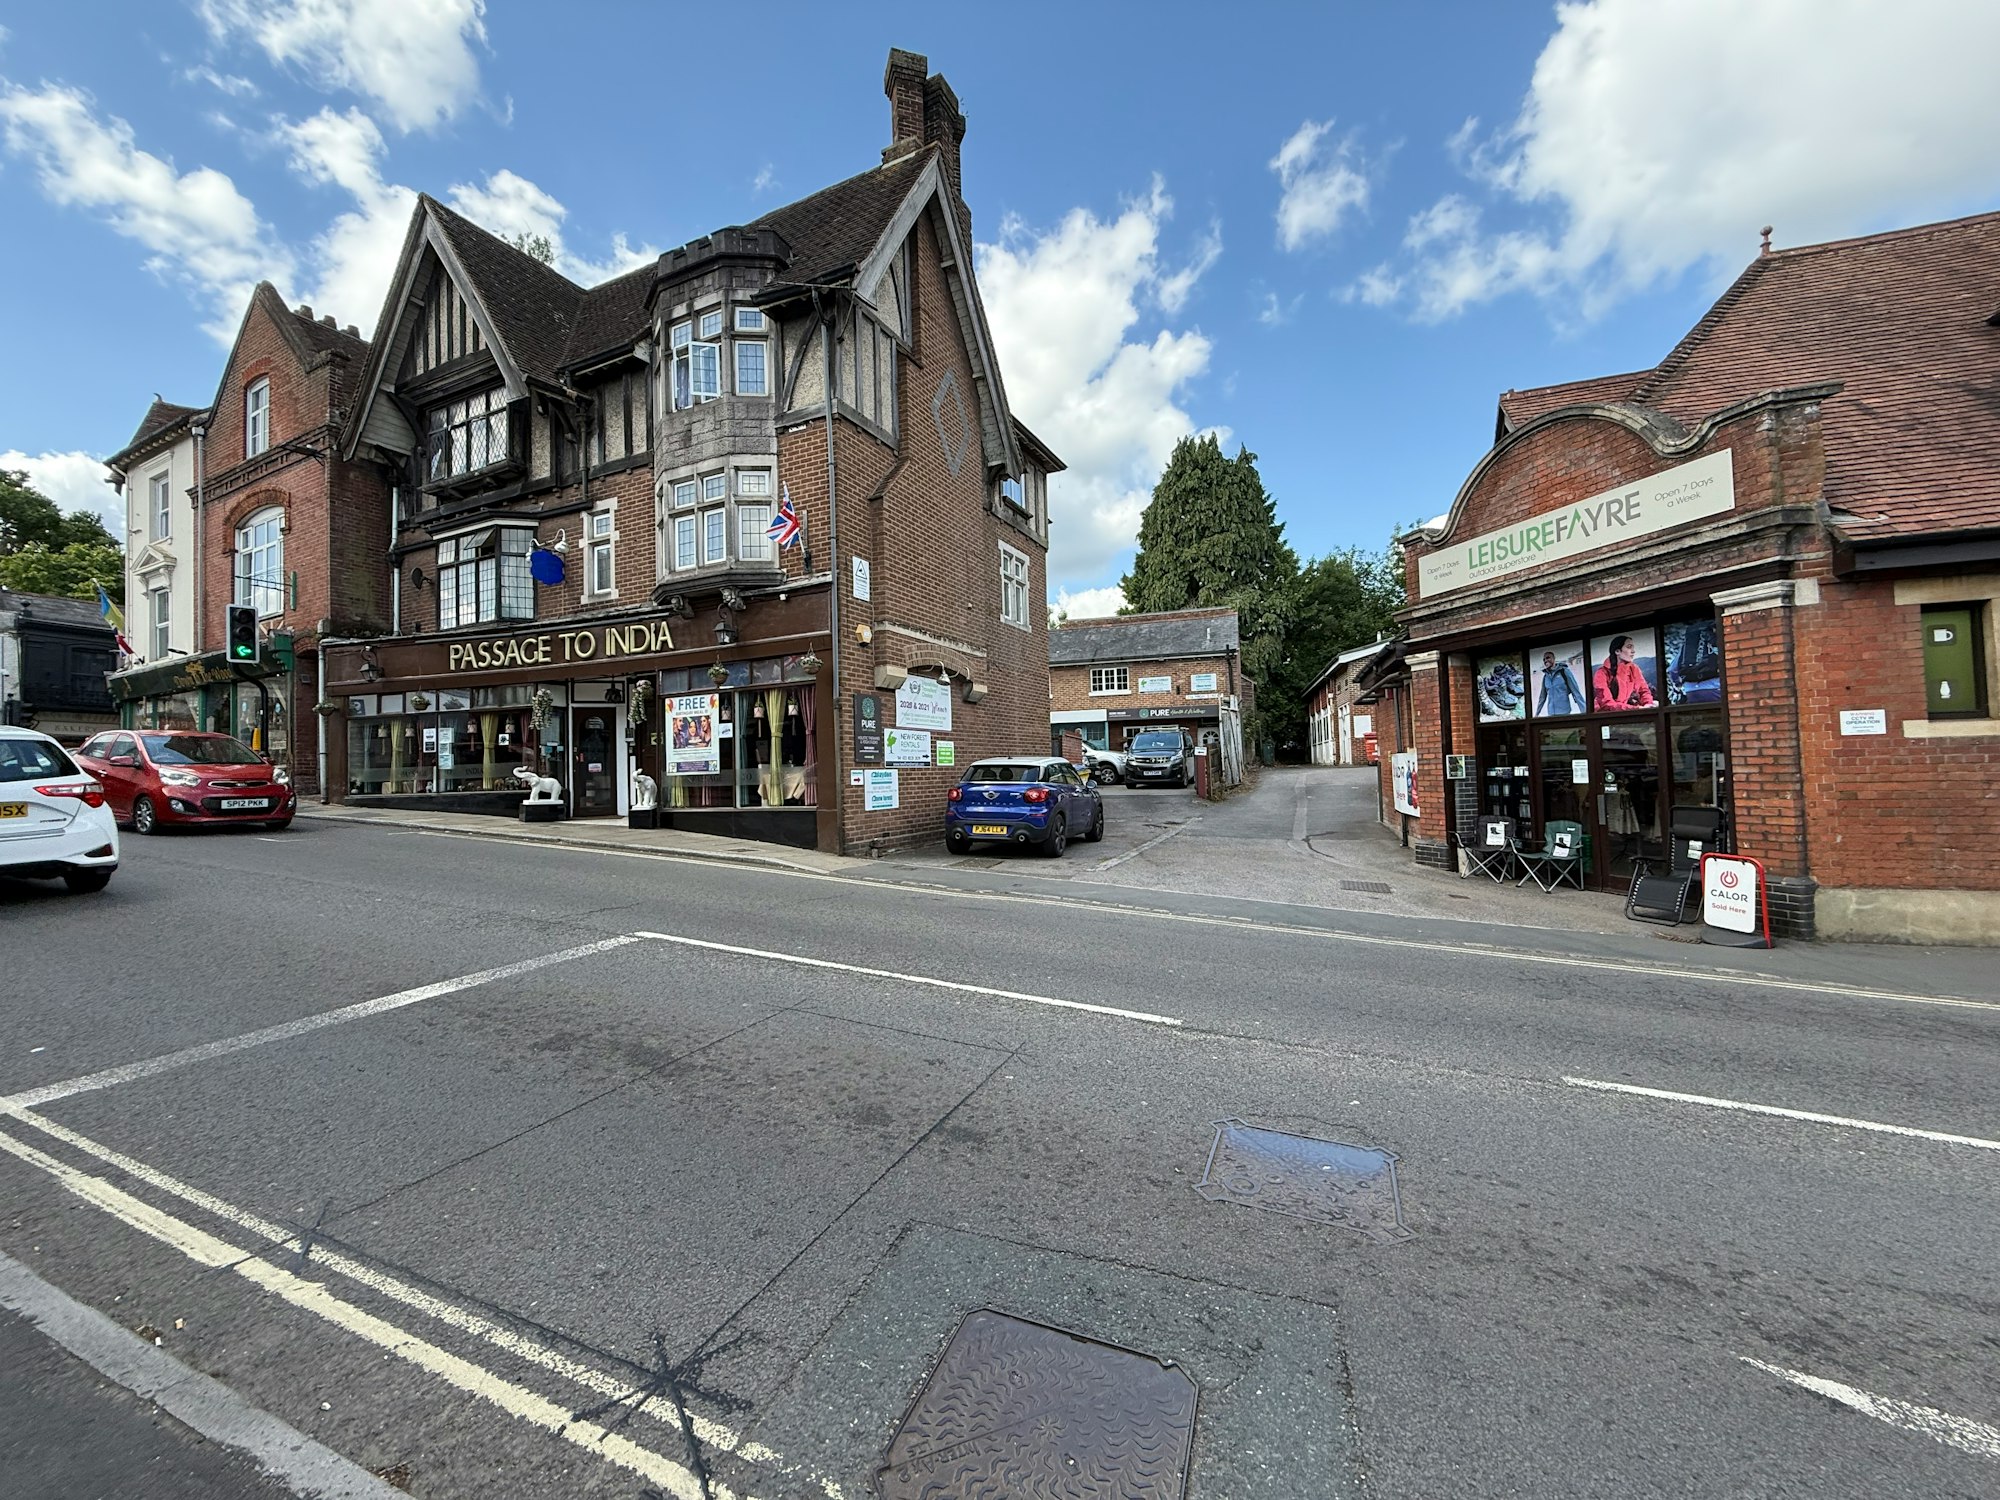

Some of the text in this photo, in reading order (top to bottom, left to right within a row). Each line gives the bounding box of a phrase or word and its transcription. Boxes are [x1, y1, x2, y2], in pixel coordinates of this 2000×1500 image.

[1654, 476, 1714, 501] Open 7 Days
[1675, 492, 1701, 505] Week
[1469, 490, 1641, 570] LEISUREFAYRE
[1427, 566, 1442, 575] Open
[1468, 553, 1537, 580] outdoor superstore
[449, 621, 675, 671] PASSAGE TO INDIA
[678, 696, 706, 711] FREE
[1149, 708, 1170, 717] PURE
[861, 719, 876, 729] PURE
[911, 733, 927, 741] FOREST
[900, 741, 920, 749] RENTALS
[0, 804, 25, 816] SX
[226, 800, 246, 808] SP12
[1710, 888, 1748, 903] CALOR
[1711, 902, 1747, 914] Sold Here
